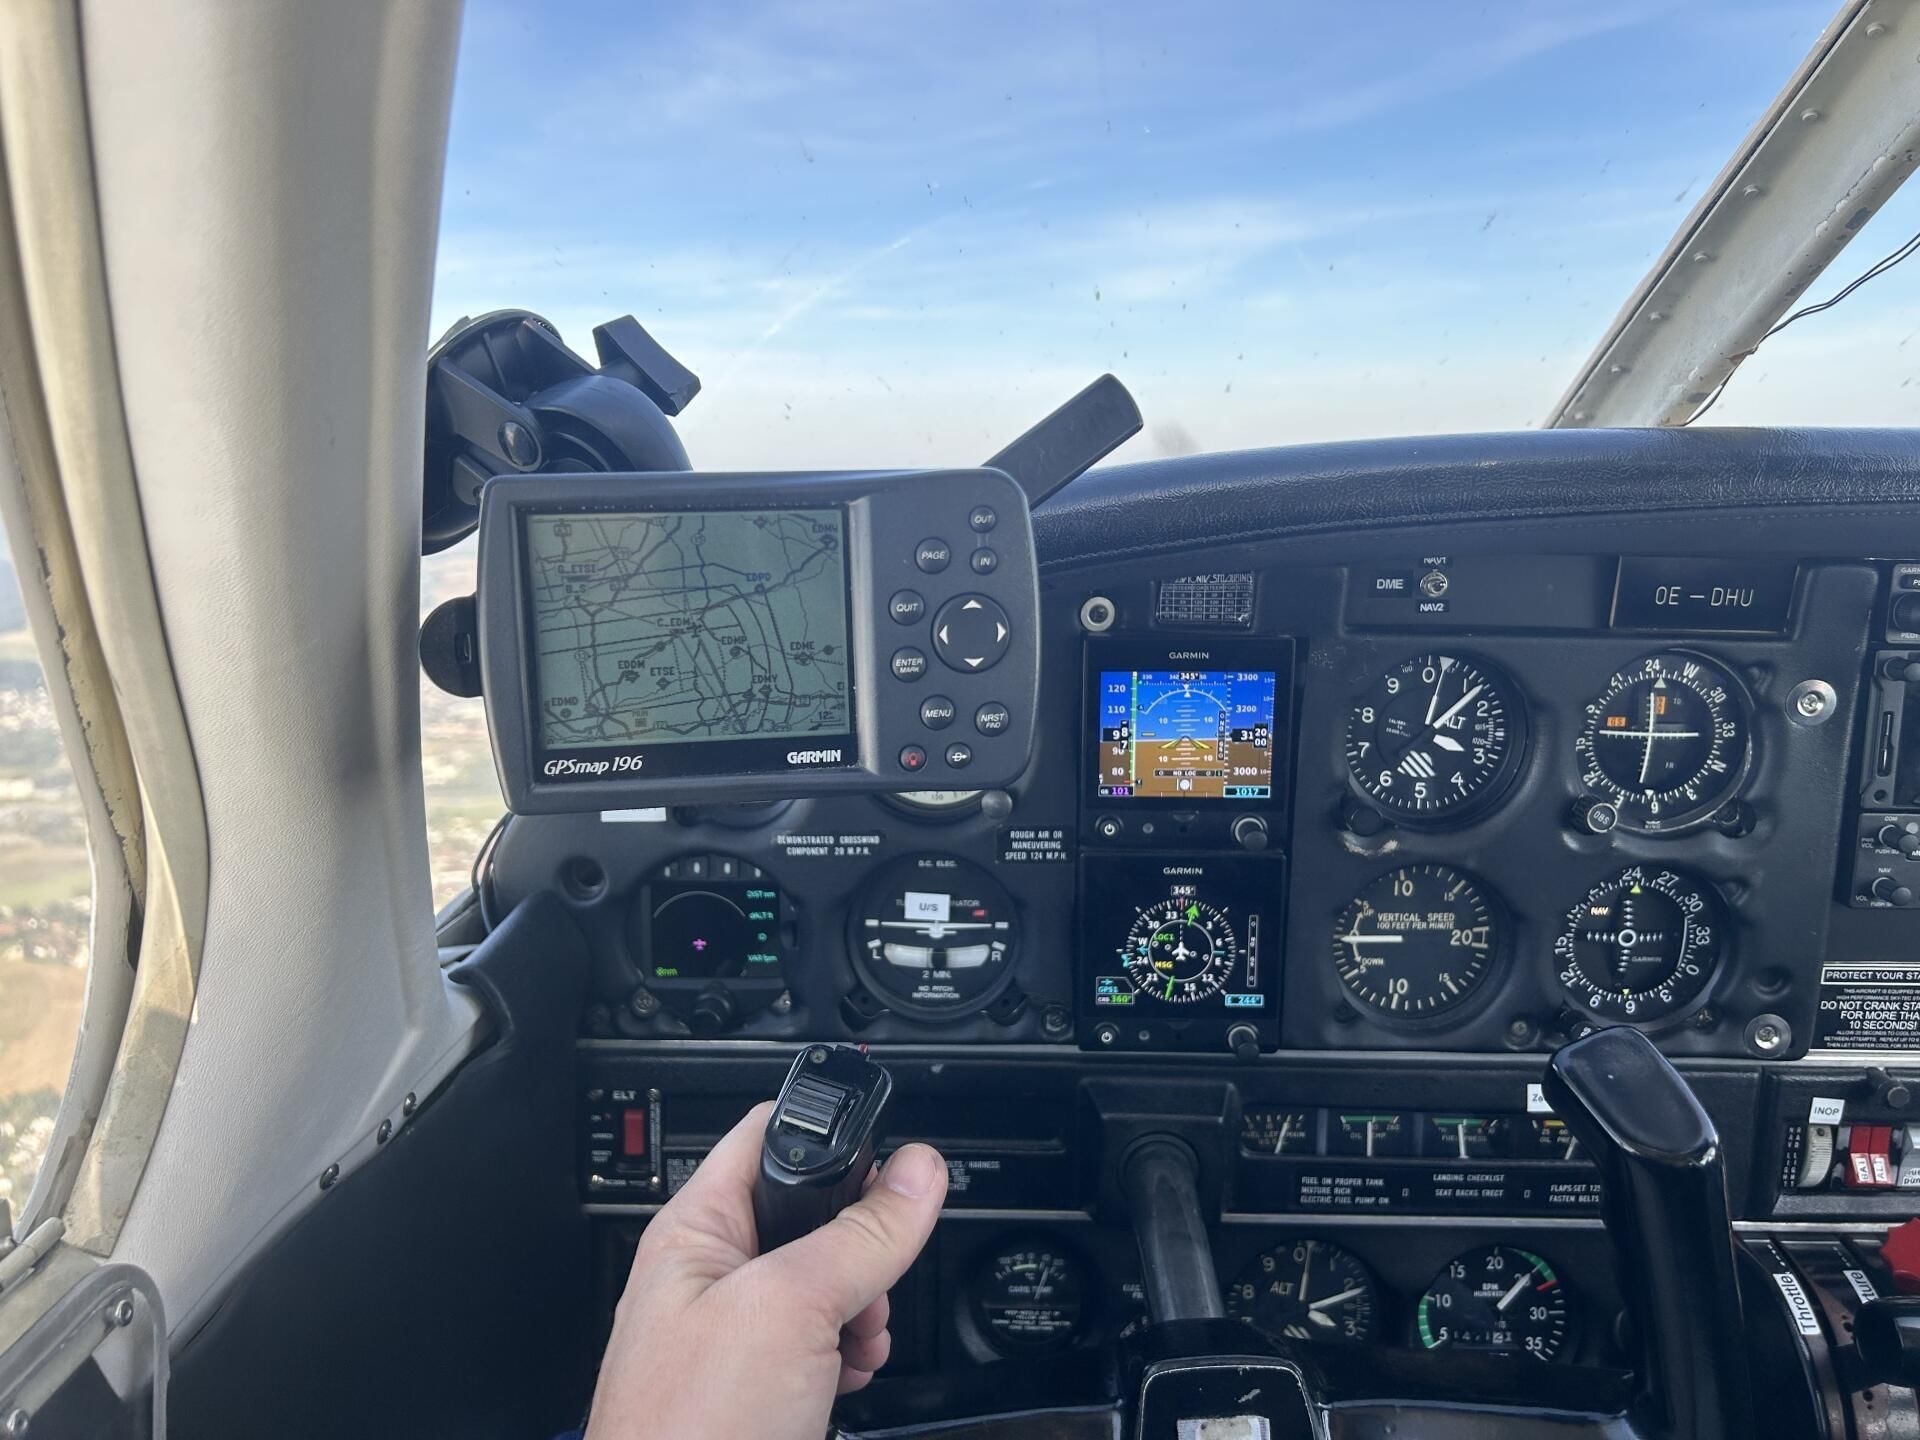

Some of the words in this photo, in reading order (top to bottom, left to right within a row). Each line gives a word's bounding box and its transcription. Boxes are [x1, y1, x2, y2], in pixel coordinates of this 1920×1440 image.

[974, 515, 992, 524] OUT
[921, 552, 945, 560] PAGE
[980, 558, 990, 566] IN
[1376, 579, 1404, 590] DME
[896, 603, 918, 612] QUIT
[1420, 604, 1444, 612] NAV2
[896, 658, 922, 667] ENTER
[1645, 658, 1660, 672] 24
[1422, 666, 1435, 683] 0
[1682, 662, 1700, 679] W
[1236, 673, 1258, 682] 3300
[1108, 685, 1126, 693] 120
[1387, 678, 1399, 694] 9
[1710, 686, 1727, 704] 30
[926, 708, 951, 718] MENU
[1108, 705, 1126, 714] 110
[1236, 704, 1257, 713] 3200
[1476, 700, 1488, 717] 2
[980, 714, 1004, 722] NRST
[1361, 707, 1374, 723] 8
[1722, 722, 1736, 738] 33
[1358, 741, 1370, 758] 7
[786, 750, 842, 764] GARMIN
[1473, 748, 1485, 764] 3
[544, 760, 609, 776] GPSmap
[612, 755, 643, 772] 196
[1112, 767, 1124, 776] 80
[1233, 767, 1258, 776] 3000
[1710, 759, 1727, 773] N
[1379, 770, 1392, 787] 6
[1450, 771, 1464, 786] 4
[1583, 770, 1599, 787] 12
[1112, 788, 1130, 796] 101
[1236, 788, 1258, 796] 1017
[1414, 782, 1426, 798] 5
[1686, 788, 1697, 801] 3
[1614, 794, 1624, 809] E
[1651, 801, 1659, 814] 6
[1593, 810, 1610, 825] OBS
[777, 835, 834, 844] DEMONSTRATED
[840, 835, 880, 844] CROSSWIND
[1010, 830, 1035, 839] ROUGH
[1038, 830, 1049, 839] AIR
[1053, 830, 1063, 839] OR
[786, 846, 828, 856] COMPONENT
[834, 846, 845, 856] 20
[1012, 841, 1061, 849] MANEUVERING
[1004, 851, 1027, 860] SPEED
[1030, 851, 1042, 860] 124
[1622, 866, 1642, 880] 24
[1656, 870, 1680, 887] 27
[1173, 886, 1195, 895] 345°
[1394, 880, 1413, 896] 10
[1444, 893, 1455, 901] 15
[1684, 892, 1704, 912] 30
[919, 902, 939, 912] U/S
[1362, 900, 1369, 909] 5
[1590, 906, 1610, 916] NAV
[1378, 913, 1421, 922] VERTICAL
[1427, 913, 1455, 922] SPEED
[1138, 938, 1148, 946] W
[1450, 929, 1473, 946] 20
[1695, 926, 1710, 946] 33
[1554, 936, 1568, 954] 15
[872, 949, 881, 960] L
[992, 951, 1002, 961] R
[1136, 956, 1148, 964] 24
[1362, 958, 1384, 966] DOWN
[1359, 965, 1367, 973] 5
[1686, 962, 1700, 976] 0
[1147, 973, 1158, 981] 21
[1438, 973, 1450, 982] 15
[1560, 968, 1578, 988] 12
[1875, 972, 1904, 980] YOUR
[1184, 982, 1196, 991] 15
[1388, 978, 1408, 995] 10
[1659, 989, 1672, 1003] 3
[1625, 1000, 1636, 1014] 6
[1820, 1001, 1837, 1010] DO
[1839, 1001, 1862, 1010] NOT
[1863, 1001, 1900, 1010] CRANK
[1840, 1011, 1864, 1020] FOR
[1865, 1011, 1897, 1020] MORE
[1850, 1020, 1860, 1029] 10
[1862, 1021, 1918, 1030] SECONDS!
[613, 1090, 637, 1100] ELT
[1813, 1107, 1840, 1115] INOP
[1302, 1176, 1318, 1184] FUEL
[1335, 1178, 1362, 1186] PROPER
[1300, 1196, 1332, 1204] ELECTRIC
[1293, 1247, 1306, 1262] 0
[1262, 1257, 1275, 1272] 9
[1486, 1256, 1503, 1269] 20
[1450, 1266, 1465, 1278] 15
[1242, 1284, 1254, 1299] 8
[1270, 1281, 1294, 1295] ALT
[1851, 1271, 1875, 1302] ture
[1436, 1294, 1451, 1307] 10
[1781, 1274, 1816, 1333] Throttle
[1530, 1307, 1546, 1320] 30
[1345, 1320, 1356, 1336] 3
[1439, 1327, 1448, 1340] 5
[1525, 1337, 1542, 1350] 35
